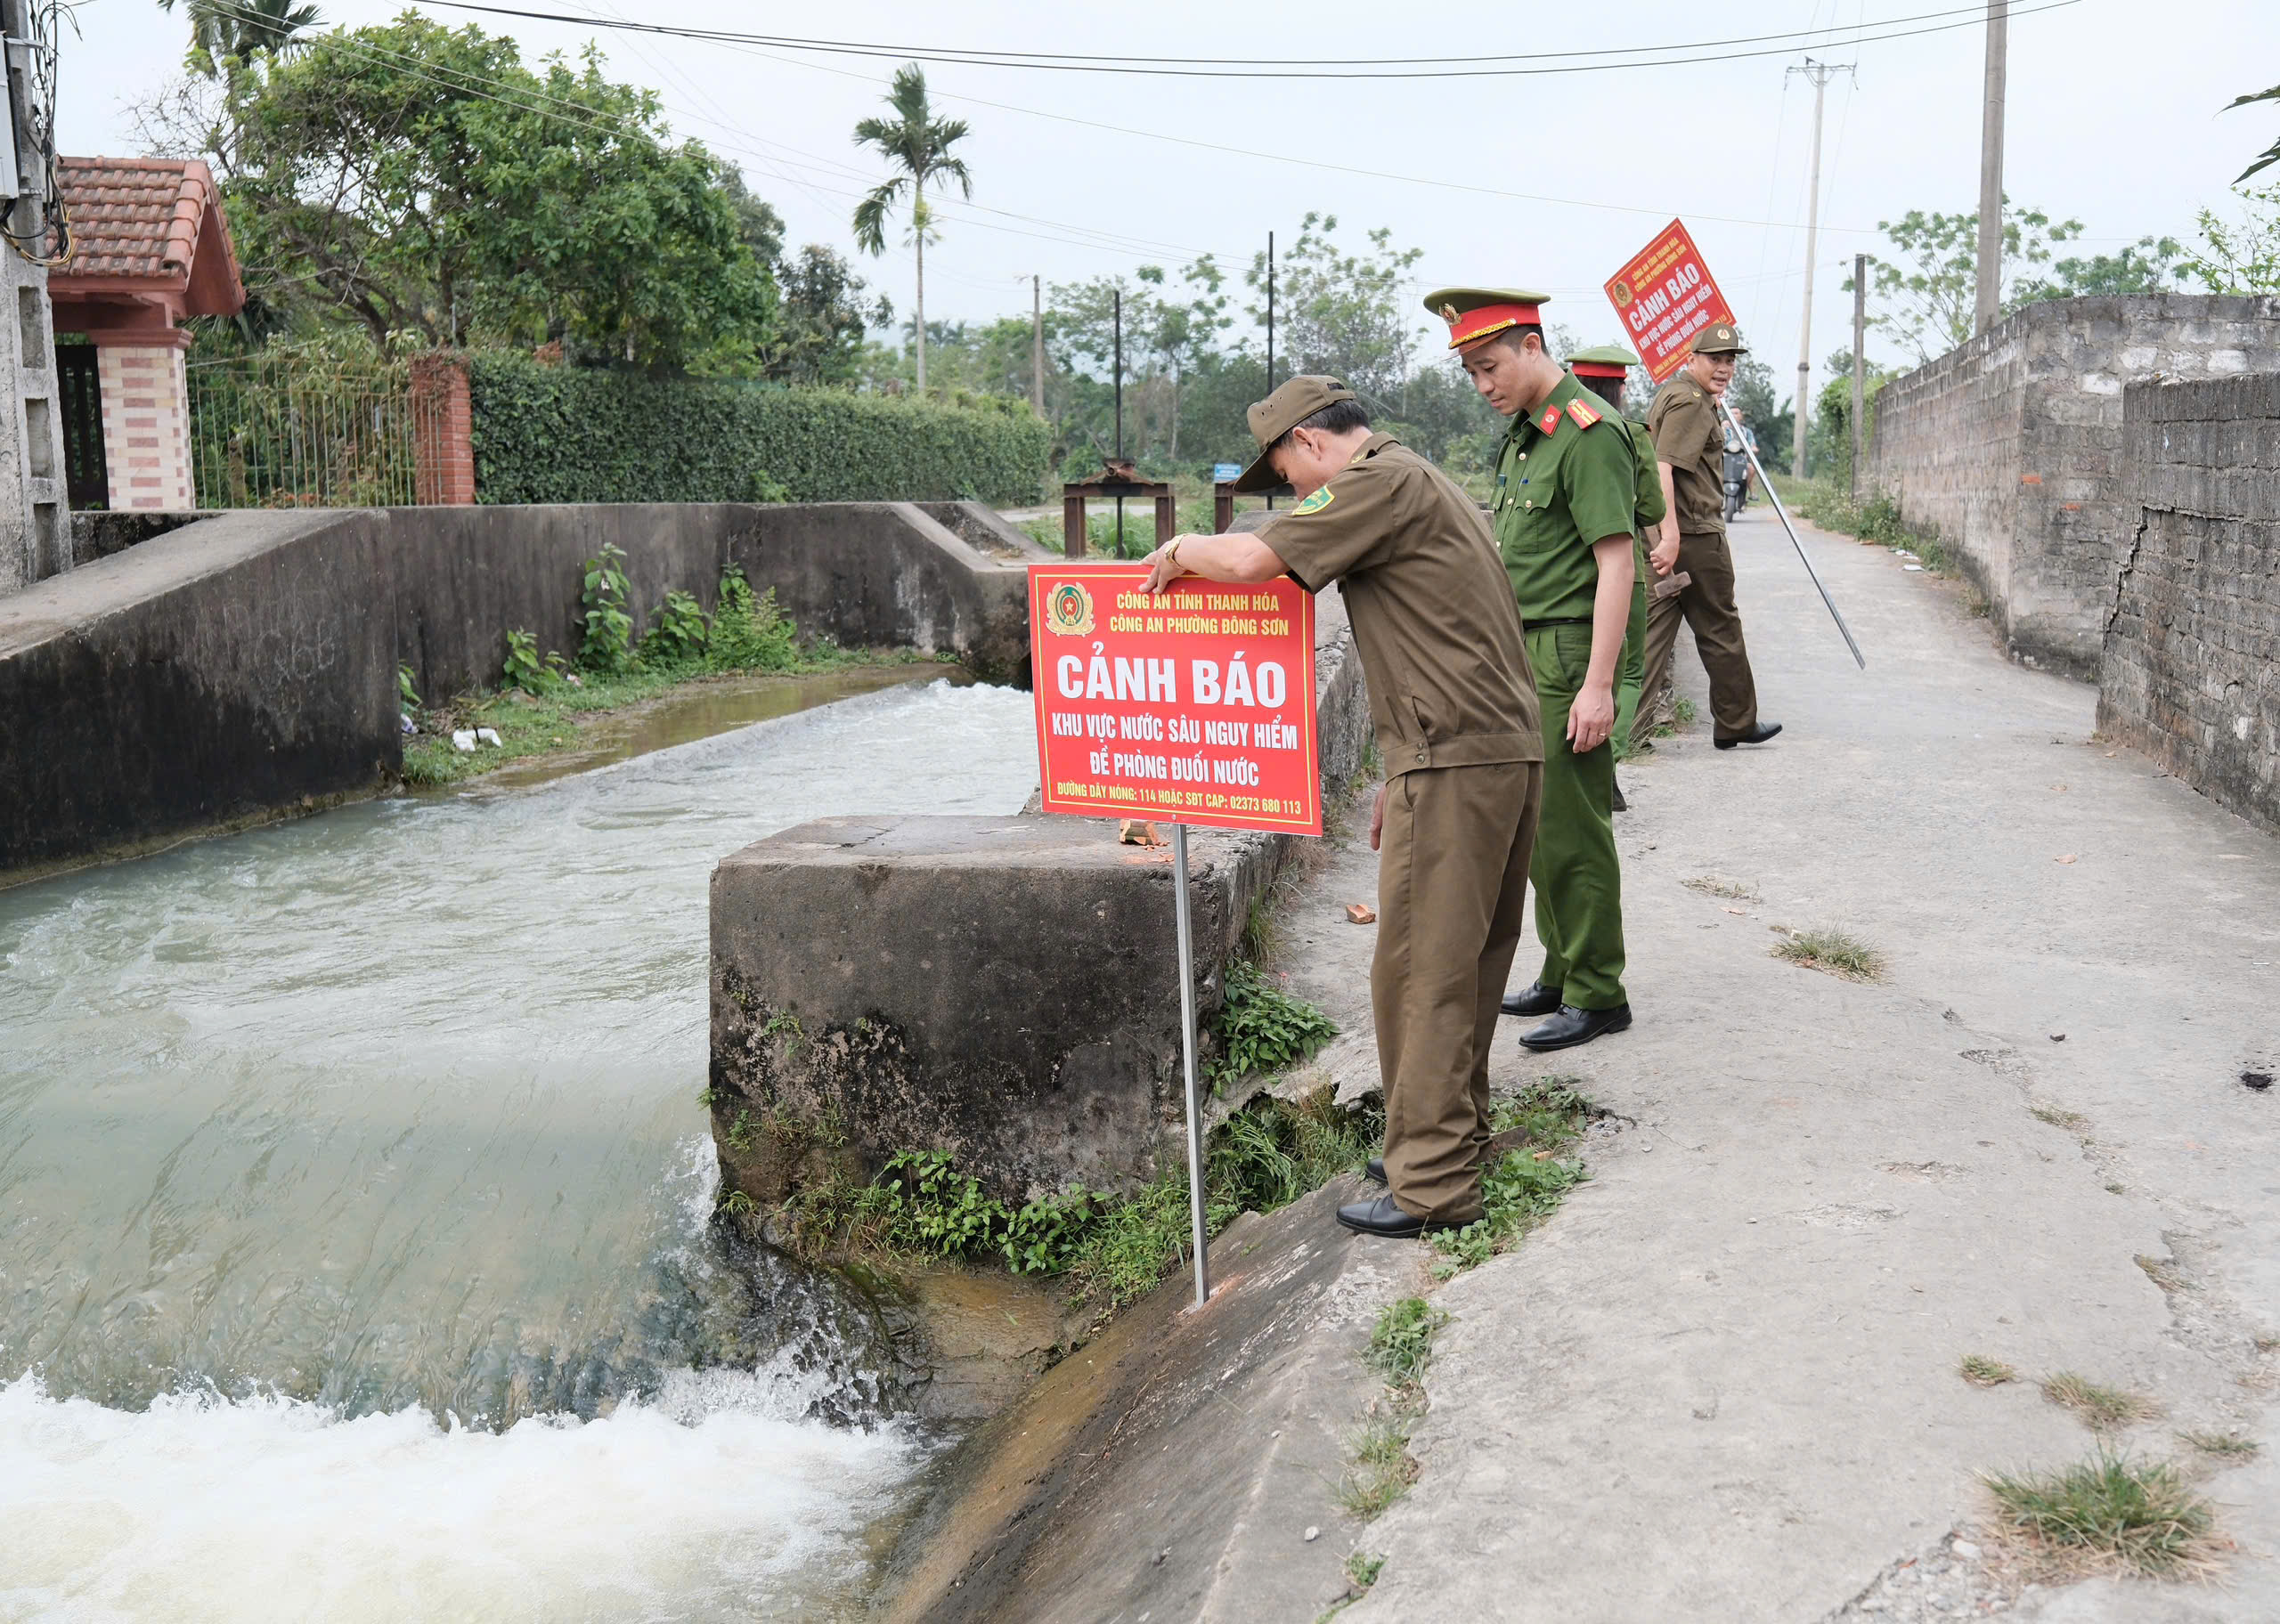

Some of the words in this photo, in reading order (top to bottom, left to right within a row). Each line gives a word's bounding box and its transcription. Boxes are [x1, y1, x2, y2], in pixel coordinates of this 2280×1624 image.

[1628, 298, 1670, 332] CẢNH
[1665, 263, 1700, 301] BÁO
[1117, 591, 1149, 609] CÔNG
[1153, 593, 1170, 610] AN
[1174, 589, 1202, 611] TỈNH
[1207, 594, 1249, 611] THANH
[1252, 591, 1279, 612] HÓA
[1110, 613, 1144, 632] CÔNG
[1147, 617, 1163, 633] AN
[1168, 614, 1218, 635] PHƯỜNG
[1222, 615, 1258, 636] ĐÔNG
[1261, 618, 1288, 636] SƠN
[1056, 641, 1177, 703] CẢNH
[1192, 650, 1286, 708] BÁO
[1052, 712, 1082, 737] KHU
[1087, 715, 1116, 743] VỰC
[1120, 713, 1163, 742] NƯỚC
[1168, 715, 1201, 744] SÂU
[1206, 720, 1249, 747] NGUY
[1254, 715, 1298, 750] HIỂM
[1090, 744, 1110, 776] ĐỀ
[1115, 749, 1167, 780] PHÒNG
[1171, 750, 1209, 784] ĐUỐI
[1214, 757, 1259, 787] NƯỚC
[1057, 780, 1087, 797] ĐƯỜNG
[1090, 783, 1106, 799] DÂY
[1110, 784, 1137, 801] NÓNG:
[1140, 789, 1156, 803] 114
[1159, 789, 1183, 807] HOẶC
[1185, 792, 1203, 807] SĐT
[1206, 794, 1227, 808] CAP:
[1231, 795, 1259, 812] 02373
[1262, 799, 1281, 813] 680
[1282, 800, 1301, 816] 113
